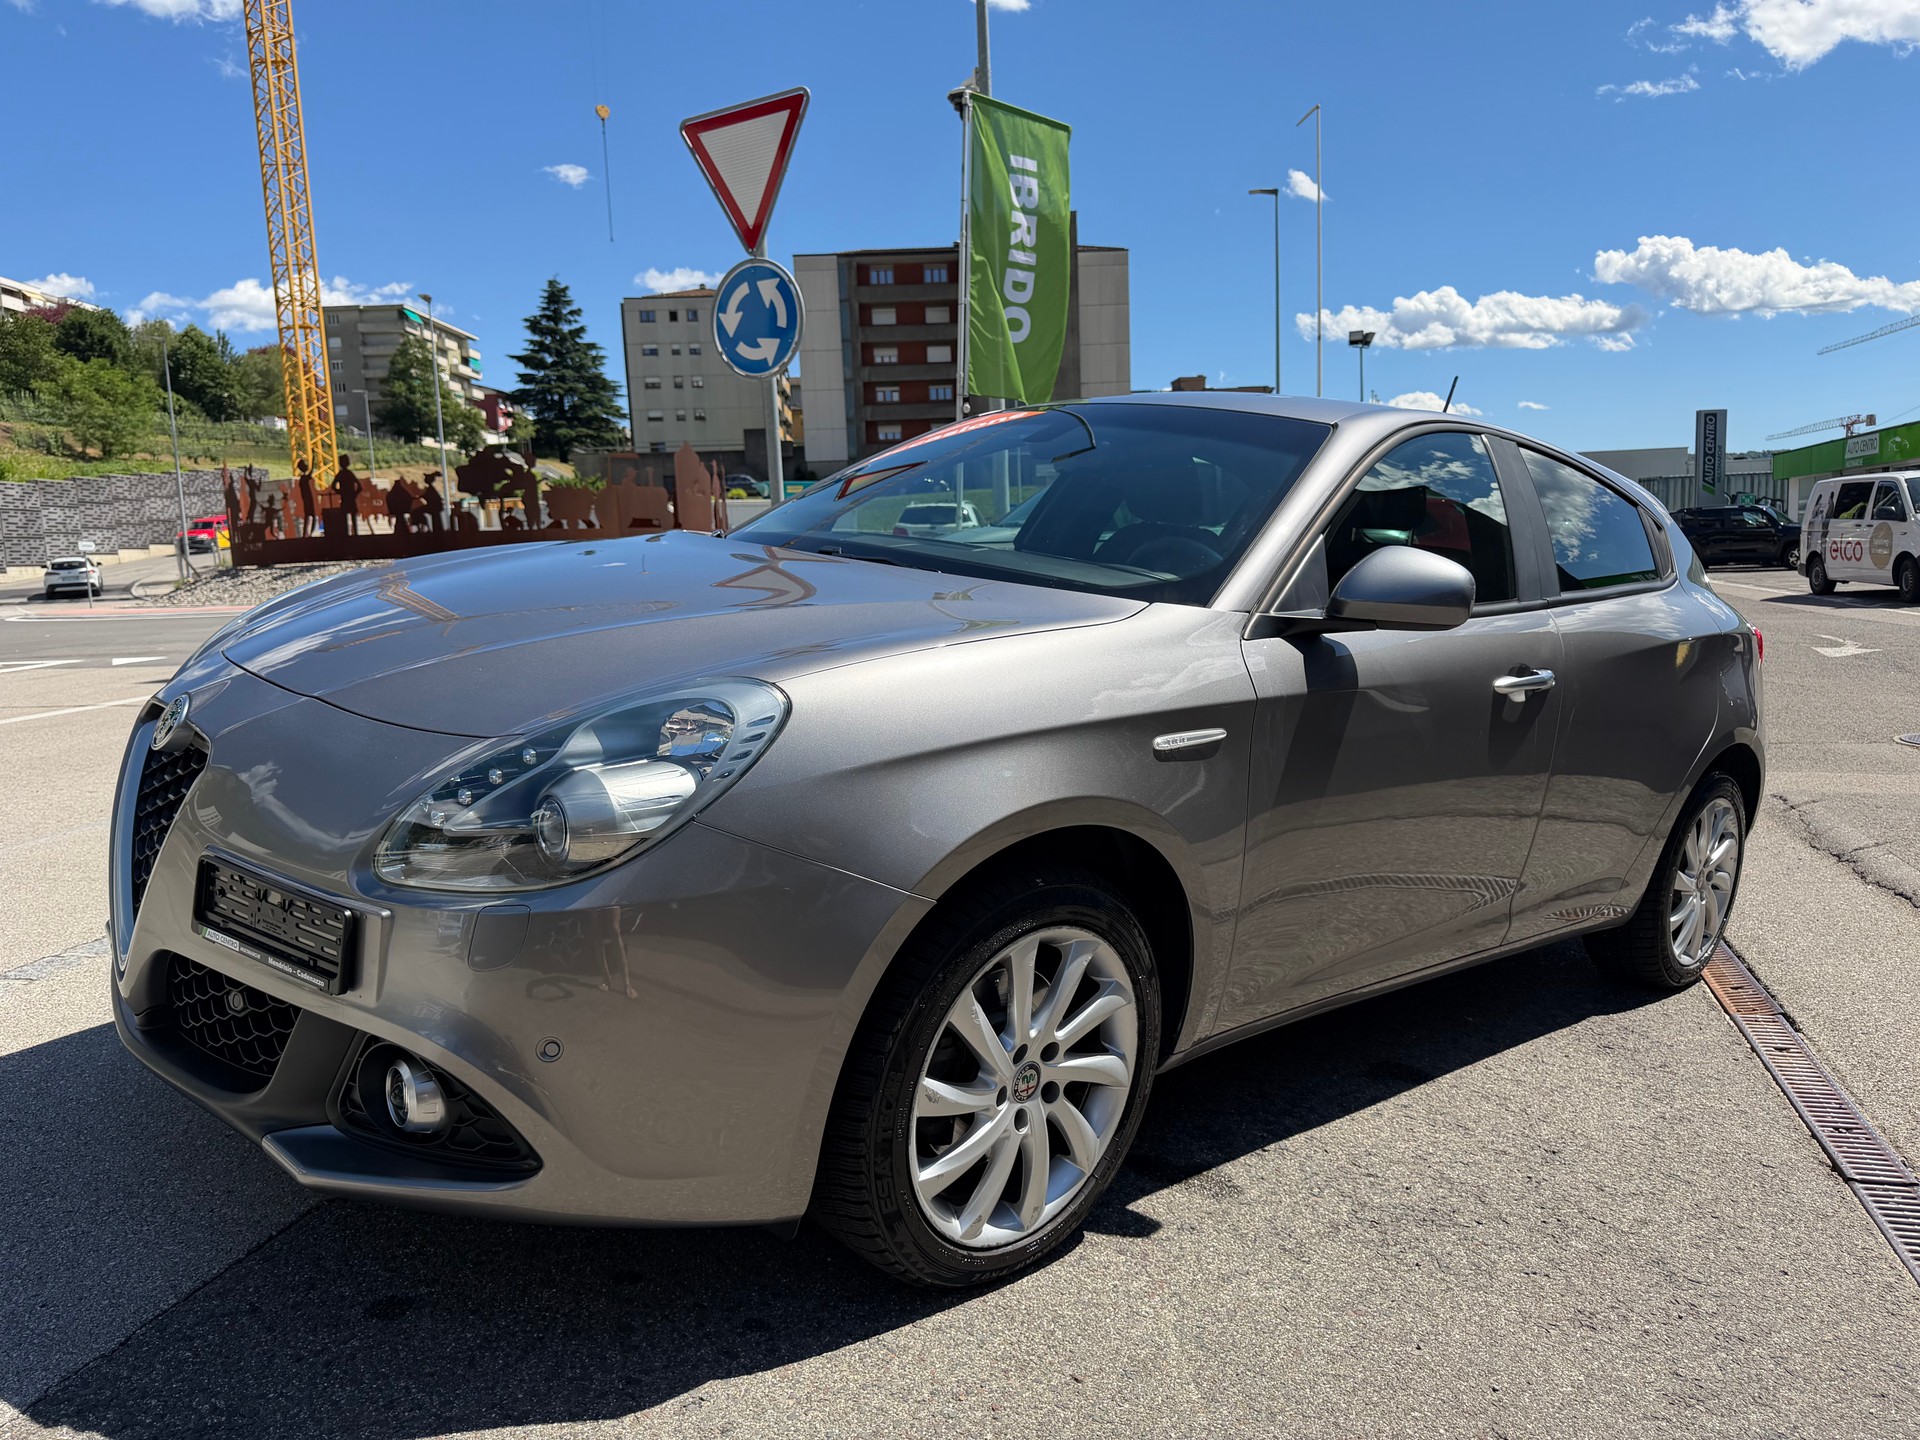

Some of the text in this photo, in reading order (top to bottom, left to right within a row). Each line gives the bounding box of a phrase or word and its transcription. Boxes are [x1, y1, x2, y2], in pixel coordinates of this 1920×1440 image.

[1003, 154, 1039, 343] IBRIDO
[1704, 415, 1716, 485] AUTO CENTRO
[1860, 437, 1878, 453] CENTRO
[1829, 532, 1863, 562] elco
[206, 930, 238, 949] AUTO CENTRO
[268, 956, 293, 973] Mendrisio
[296, 969, 325, 987] Cadenazzo
